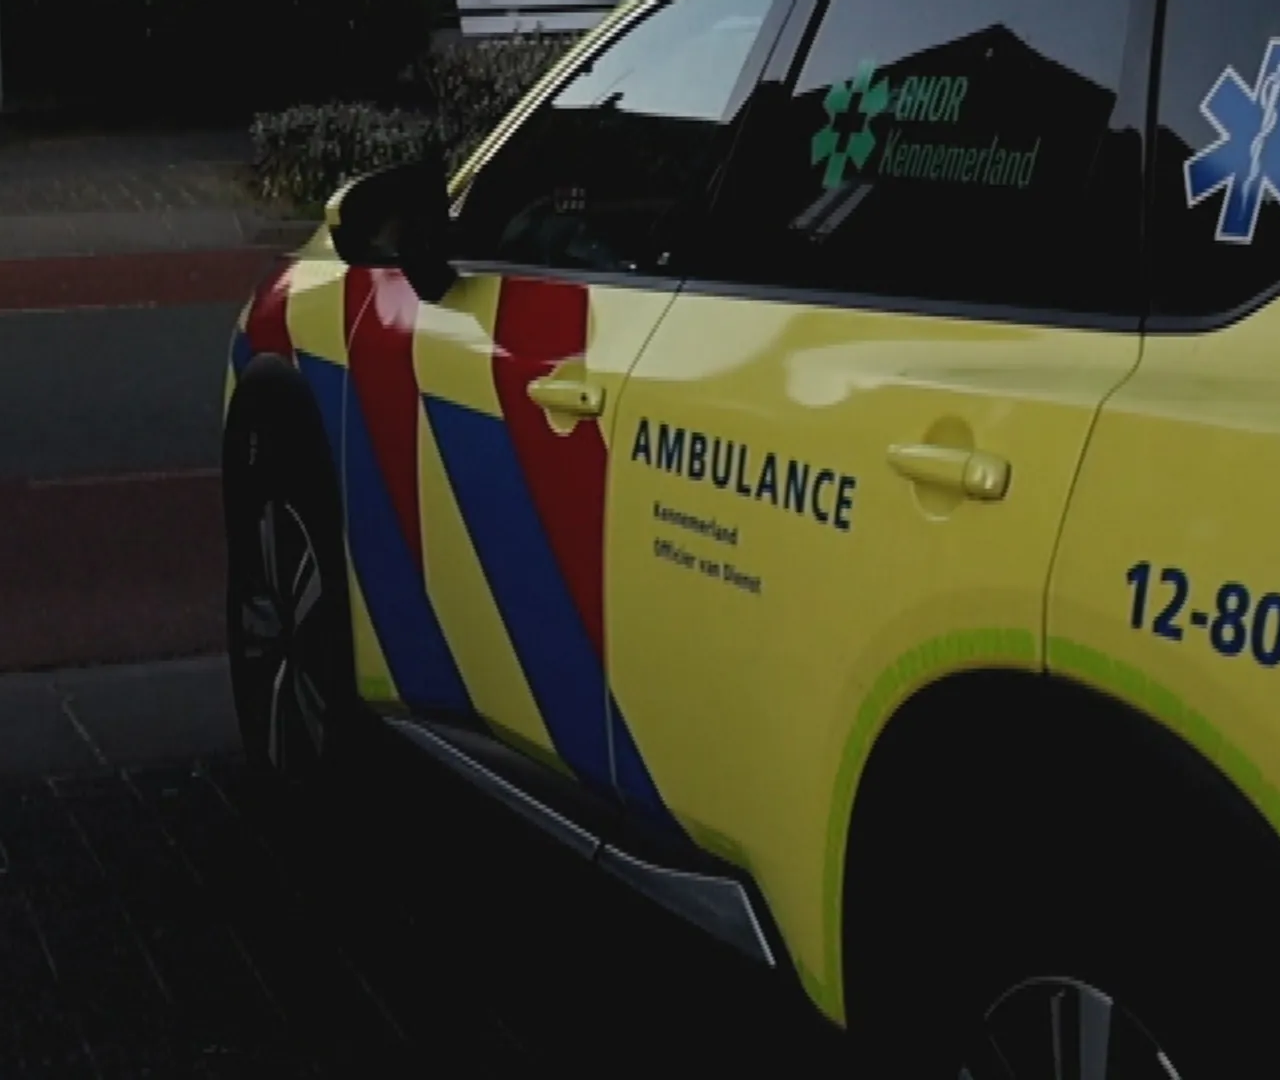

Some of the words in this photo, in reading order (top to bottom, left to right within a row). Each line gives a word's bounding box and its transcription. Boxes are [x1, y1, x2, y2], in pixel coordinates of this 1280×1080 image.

[895, 76, 968, 123] GHOR
[878, 128, 1041, 188] Kennemerland
[632, 417, 856, 529] AMBULANCE
[653, 501, 738, 545] Kennemerland
